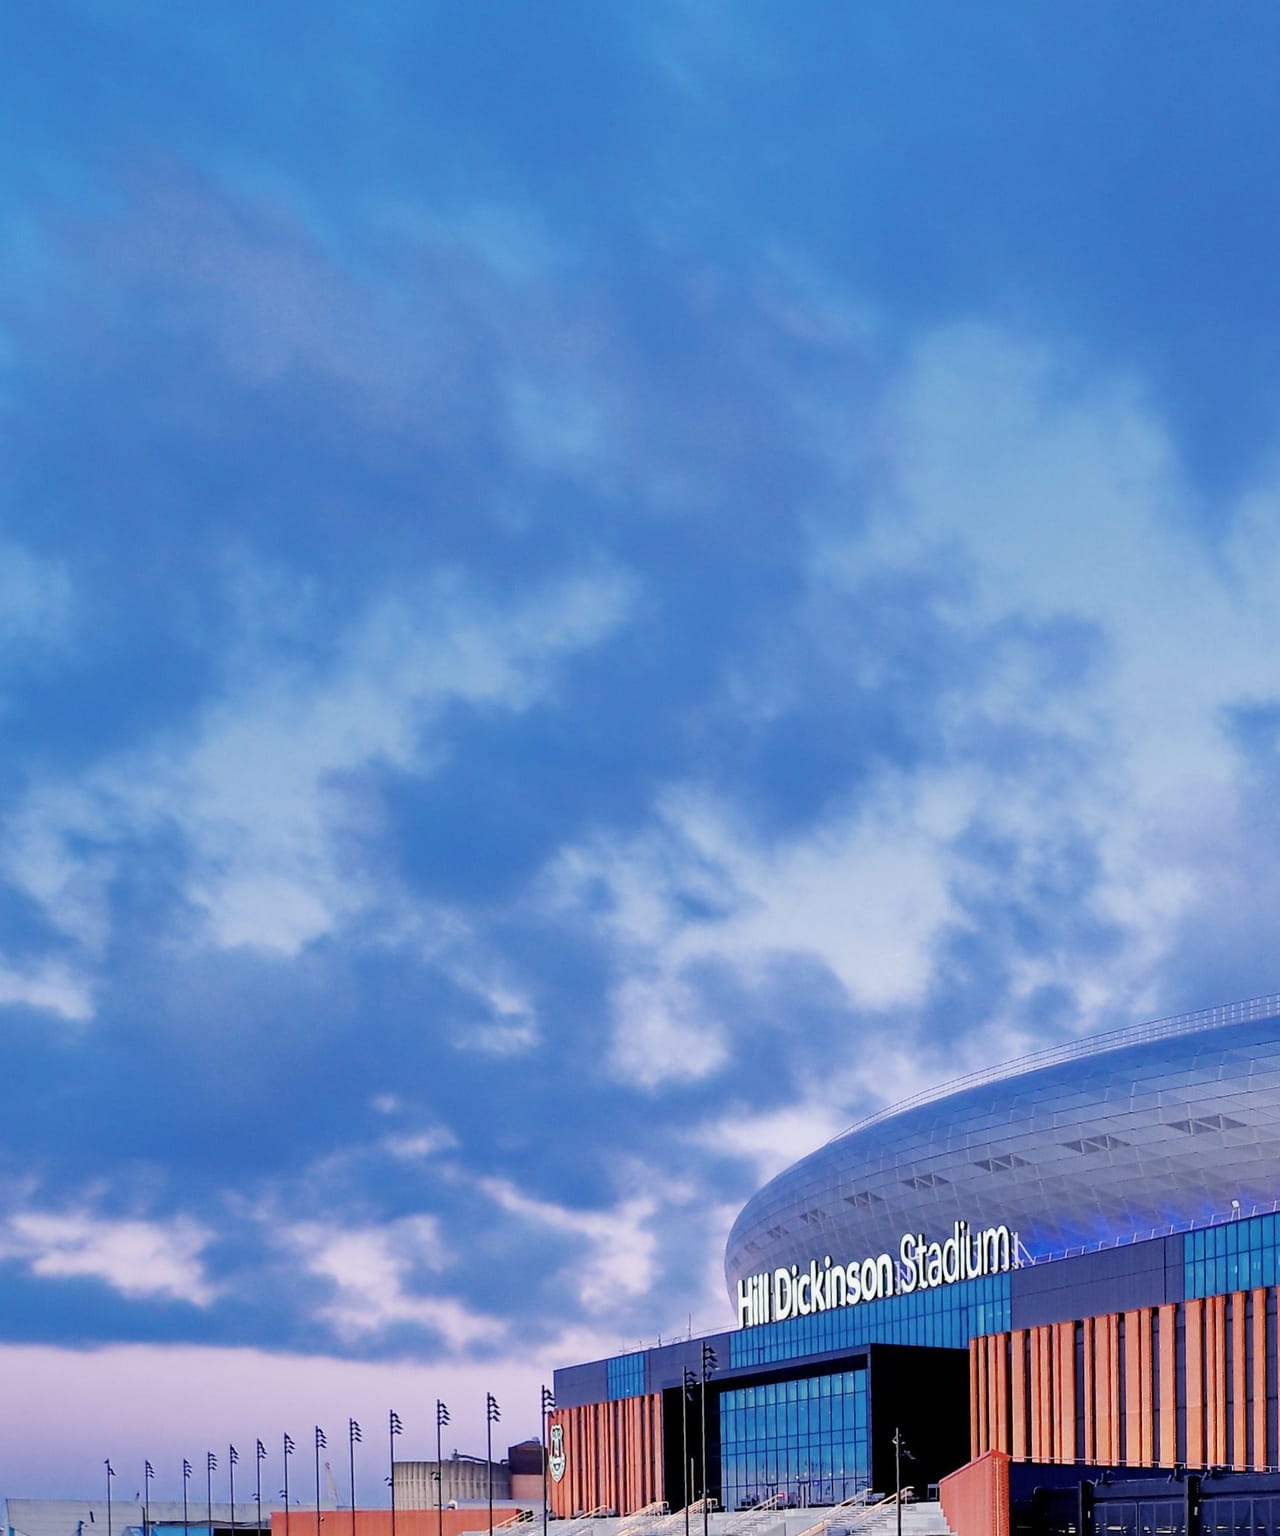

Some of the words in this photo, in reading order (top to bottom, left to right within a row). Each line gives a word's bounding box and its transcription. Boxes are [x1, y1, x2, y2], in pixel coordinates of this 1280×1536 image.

[736, 1272, 770, 1328] Hill
[773, 1255, 894, 1322] Dickinson
[899, 1220, 1011, 1293] Stadium
